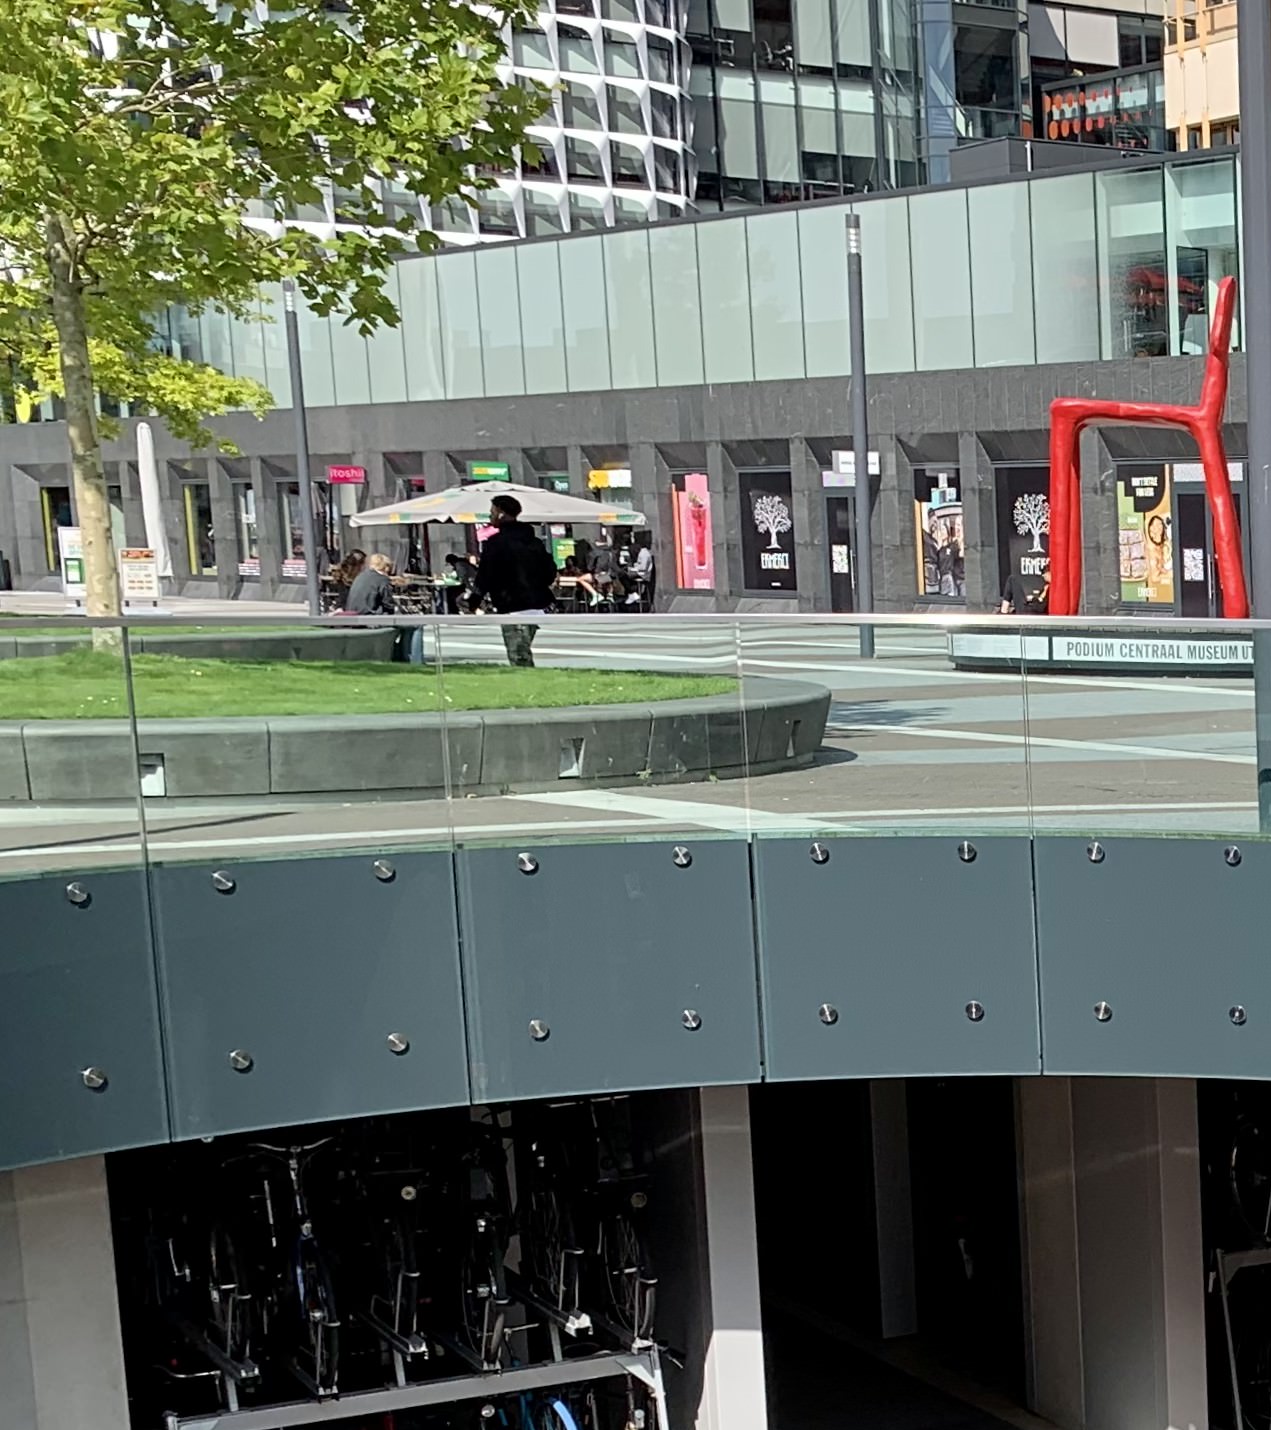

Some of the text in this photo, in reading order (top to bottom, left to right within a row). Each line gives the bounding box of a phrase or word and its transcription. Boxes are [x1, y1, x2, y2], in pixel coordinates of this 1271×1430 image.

[1066, 641, 1115, 657] PODIUM
[1119, 643, 1183, 660] CENTRAAL
[1187, 645, 1239, 660] MUSEUM
